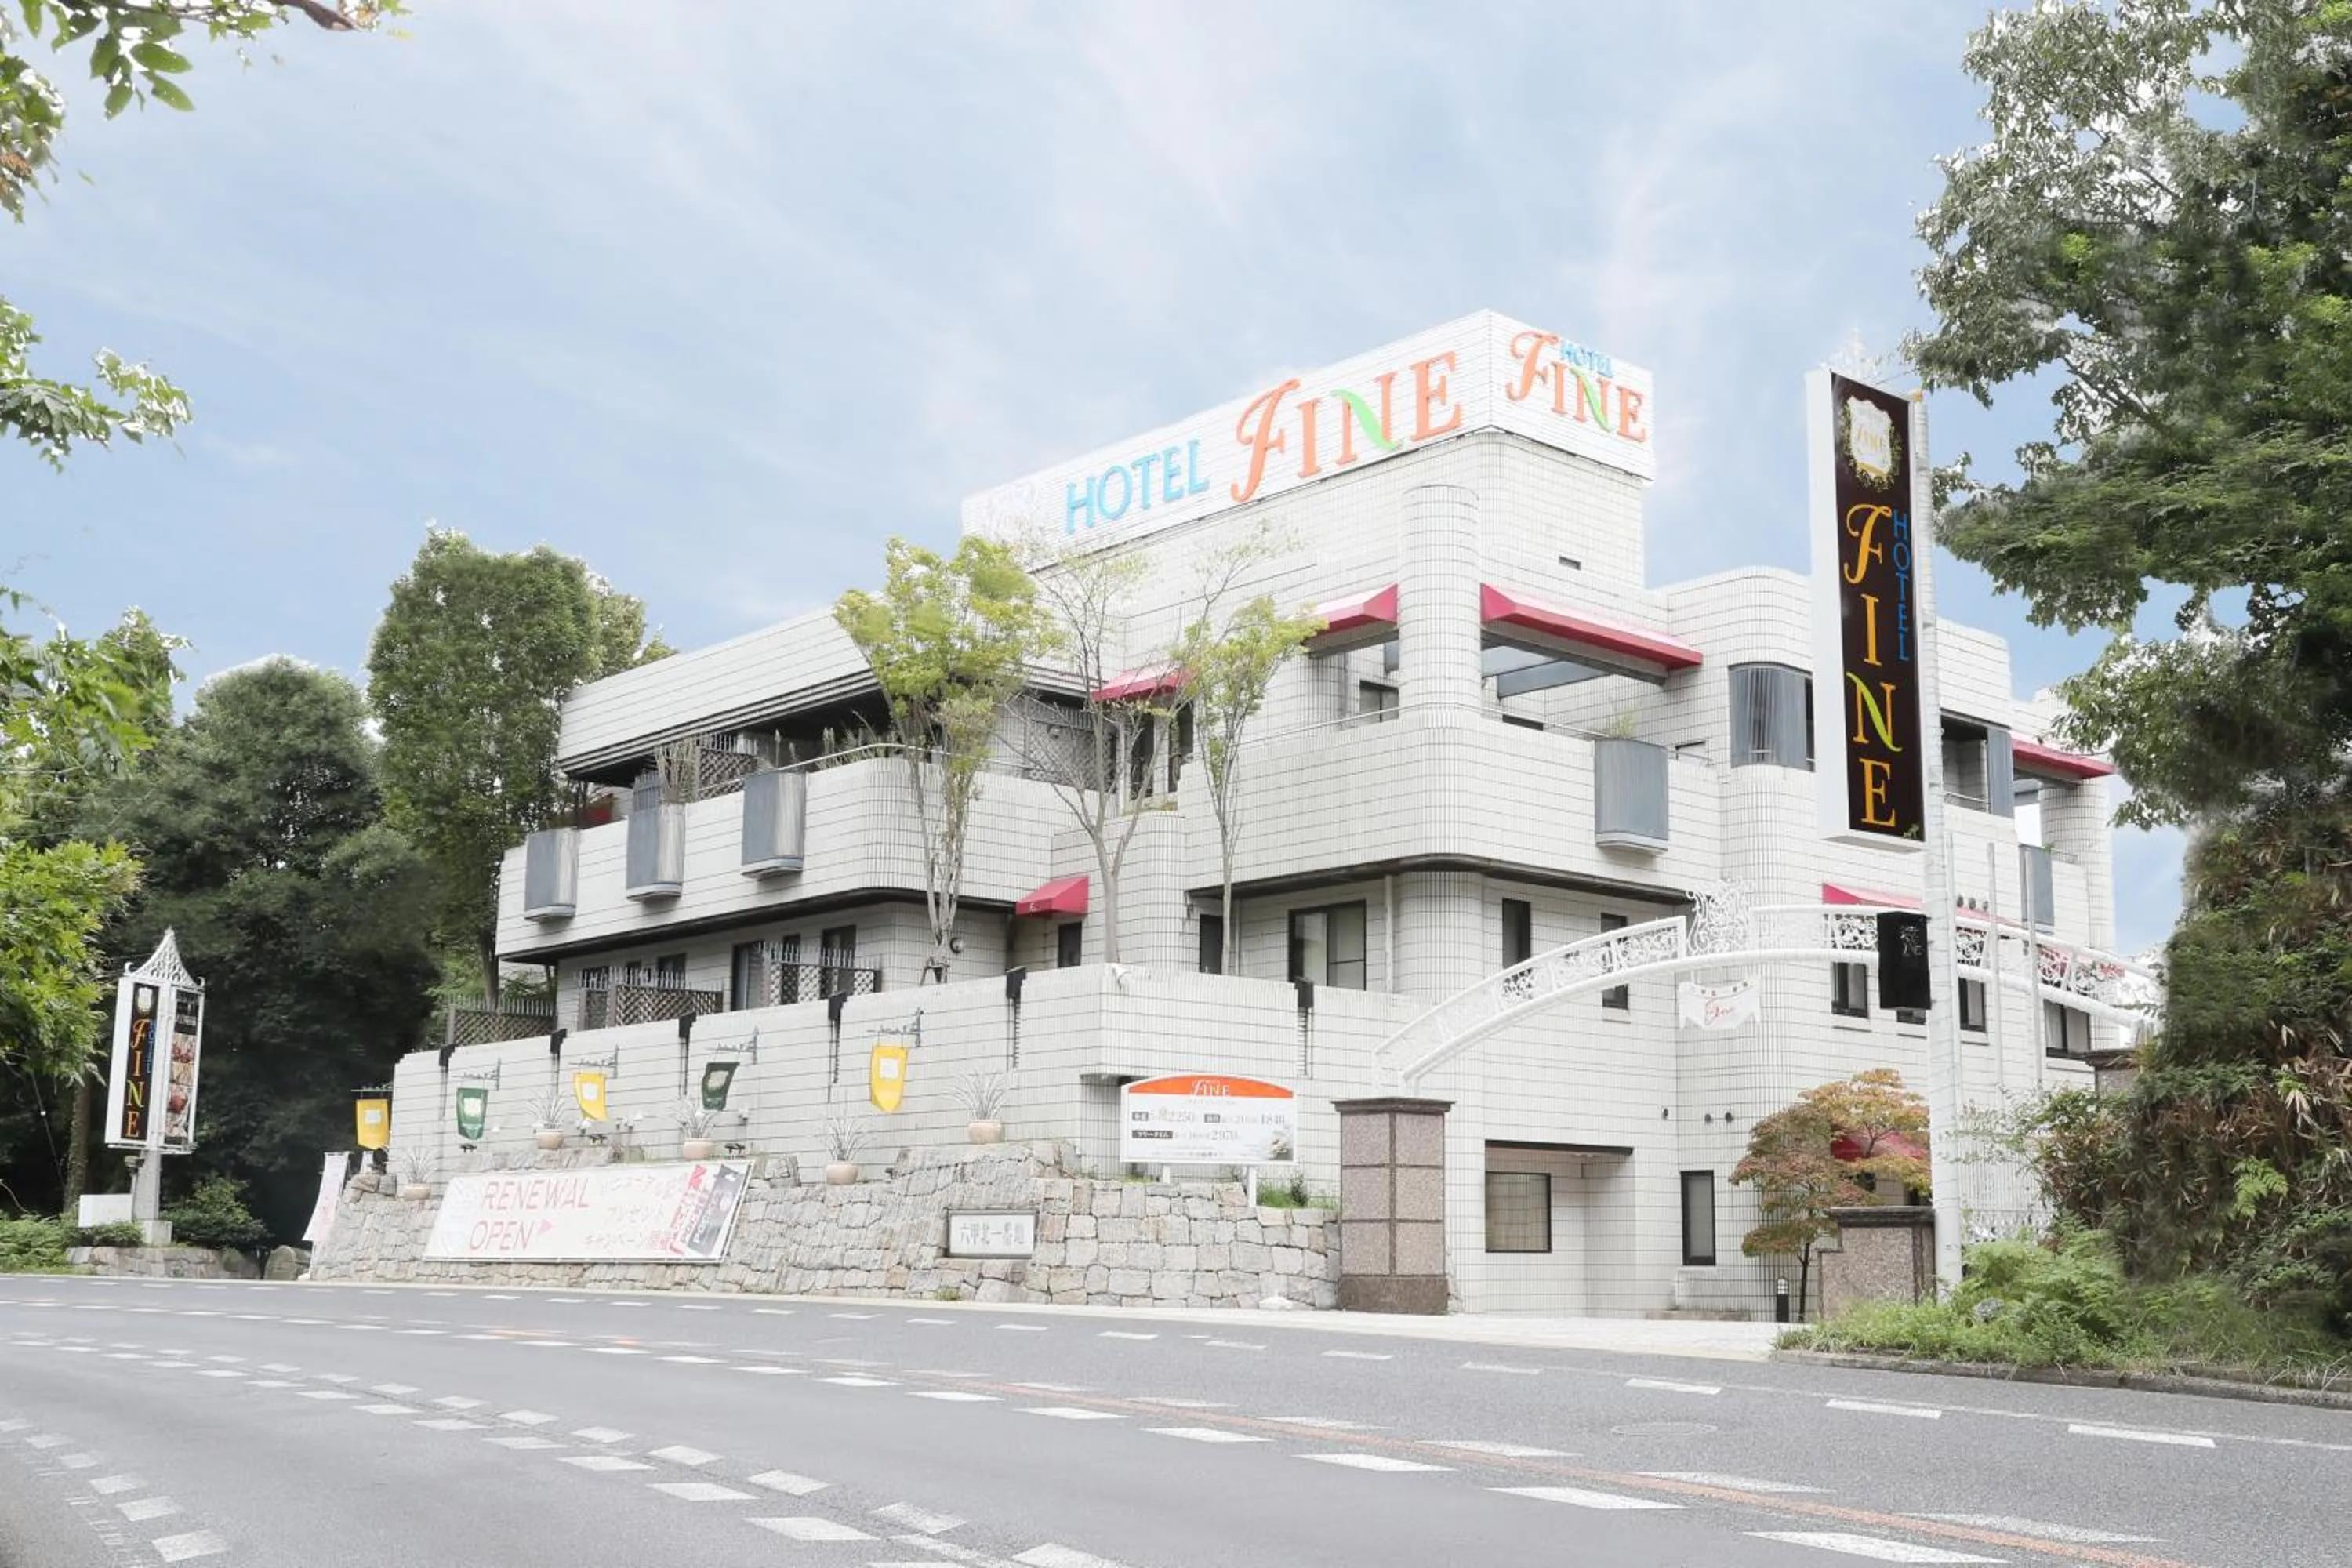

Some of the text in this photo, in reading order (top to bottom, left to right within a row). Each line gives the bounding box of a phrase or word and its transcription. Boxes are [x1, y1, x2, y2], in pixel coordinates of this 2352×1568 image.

[1505, 331, 1646, 442] FINE
[1560, 343, 1615, 378] HOTEL
[1066, 351, 1463, 534] HOTEL FINE
[1892, 508, 1910, 662] HOTEL
[1842, 503, 1904, 828] FINE
[126, 1019, 150, 1138] FINE
[469, 1219, 535, 1251] OPEN
[481, 1178, 590, 1210] RENEWAL
